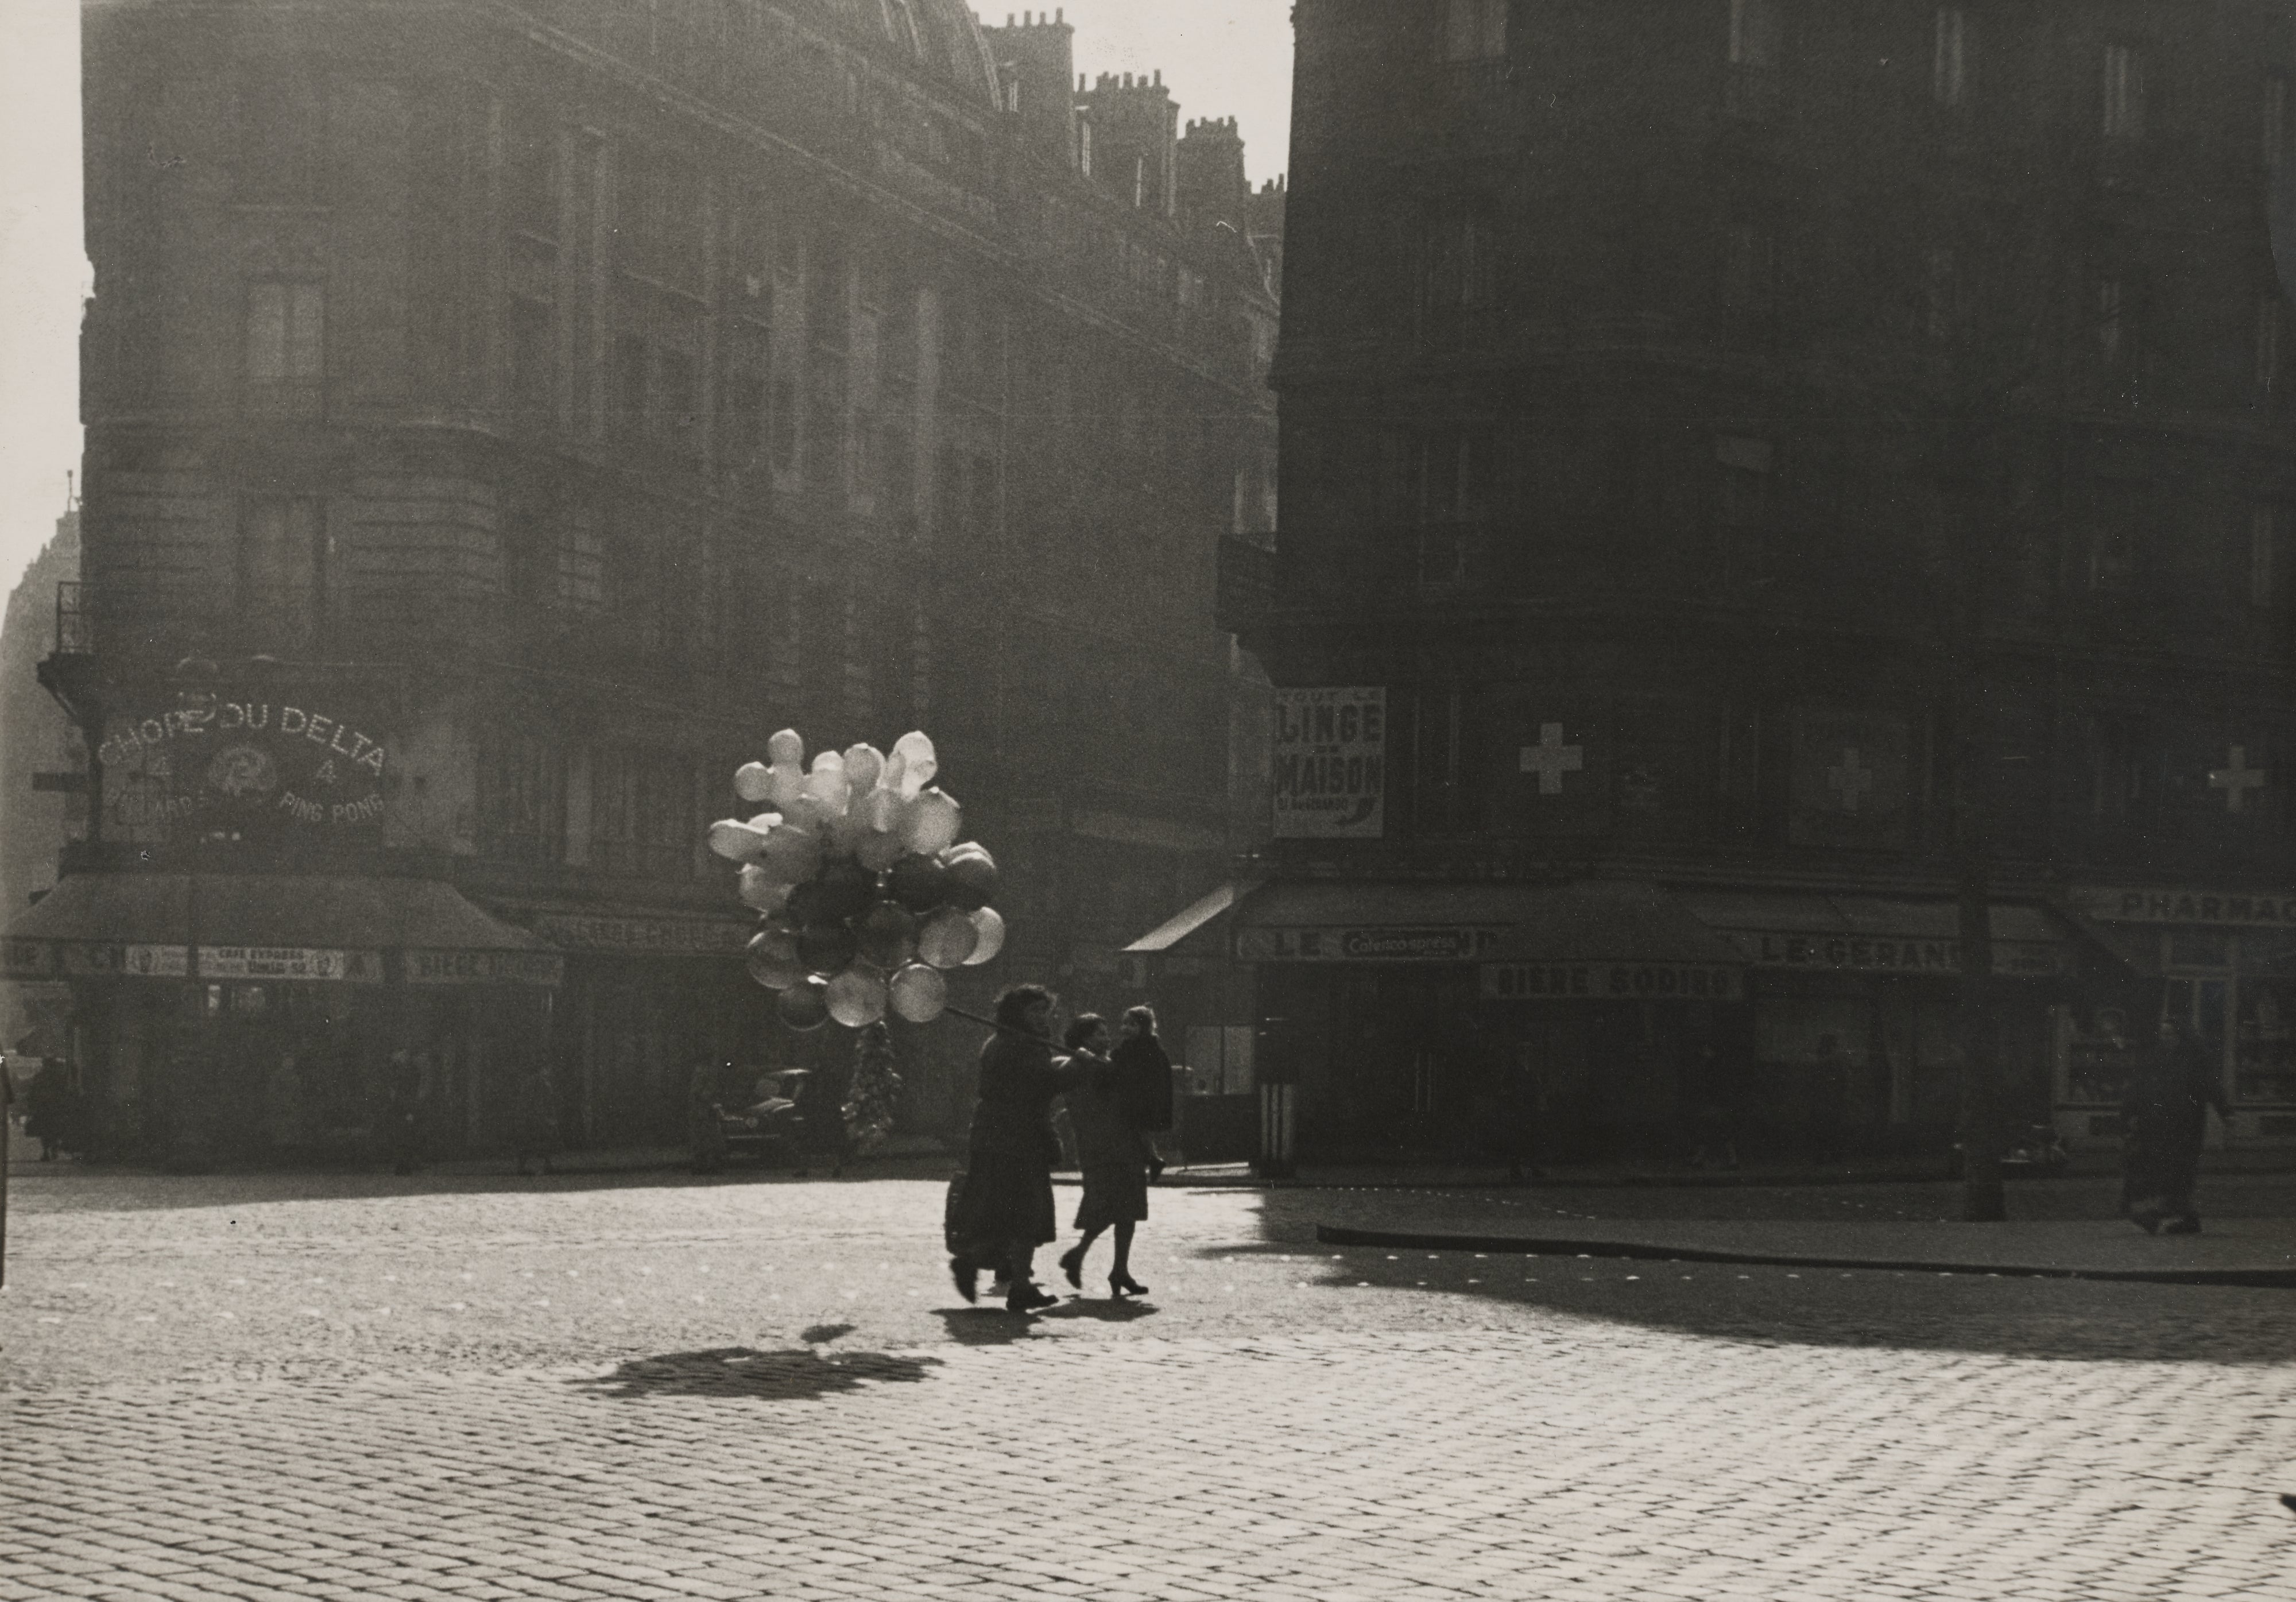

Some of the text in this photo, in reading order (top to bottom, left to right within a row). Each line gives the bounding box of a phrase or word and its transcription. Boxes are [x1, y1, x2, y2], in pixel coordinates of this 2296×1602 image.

[219, 702, 269, 730] DU
[280, 705, 385, 777] DELTA
[1277, 704, 1381, 744] LINGE
[315, 758, 338, 784] 4
[1275, 754, 1381, 798] MAISON
[278, 790, 385, 824] PING PONG
[2121, 893, 2296, 923] PHARMAC
[1761, 937, 1808, 963] LE
